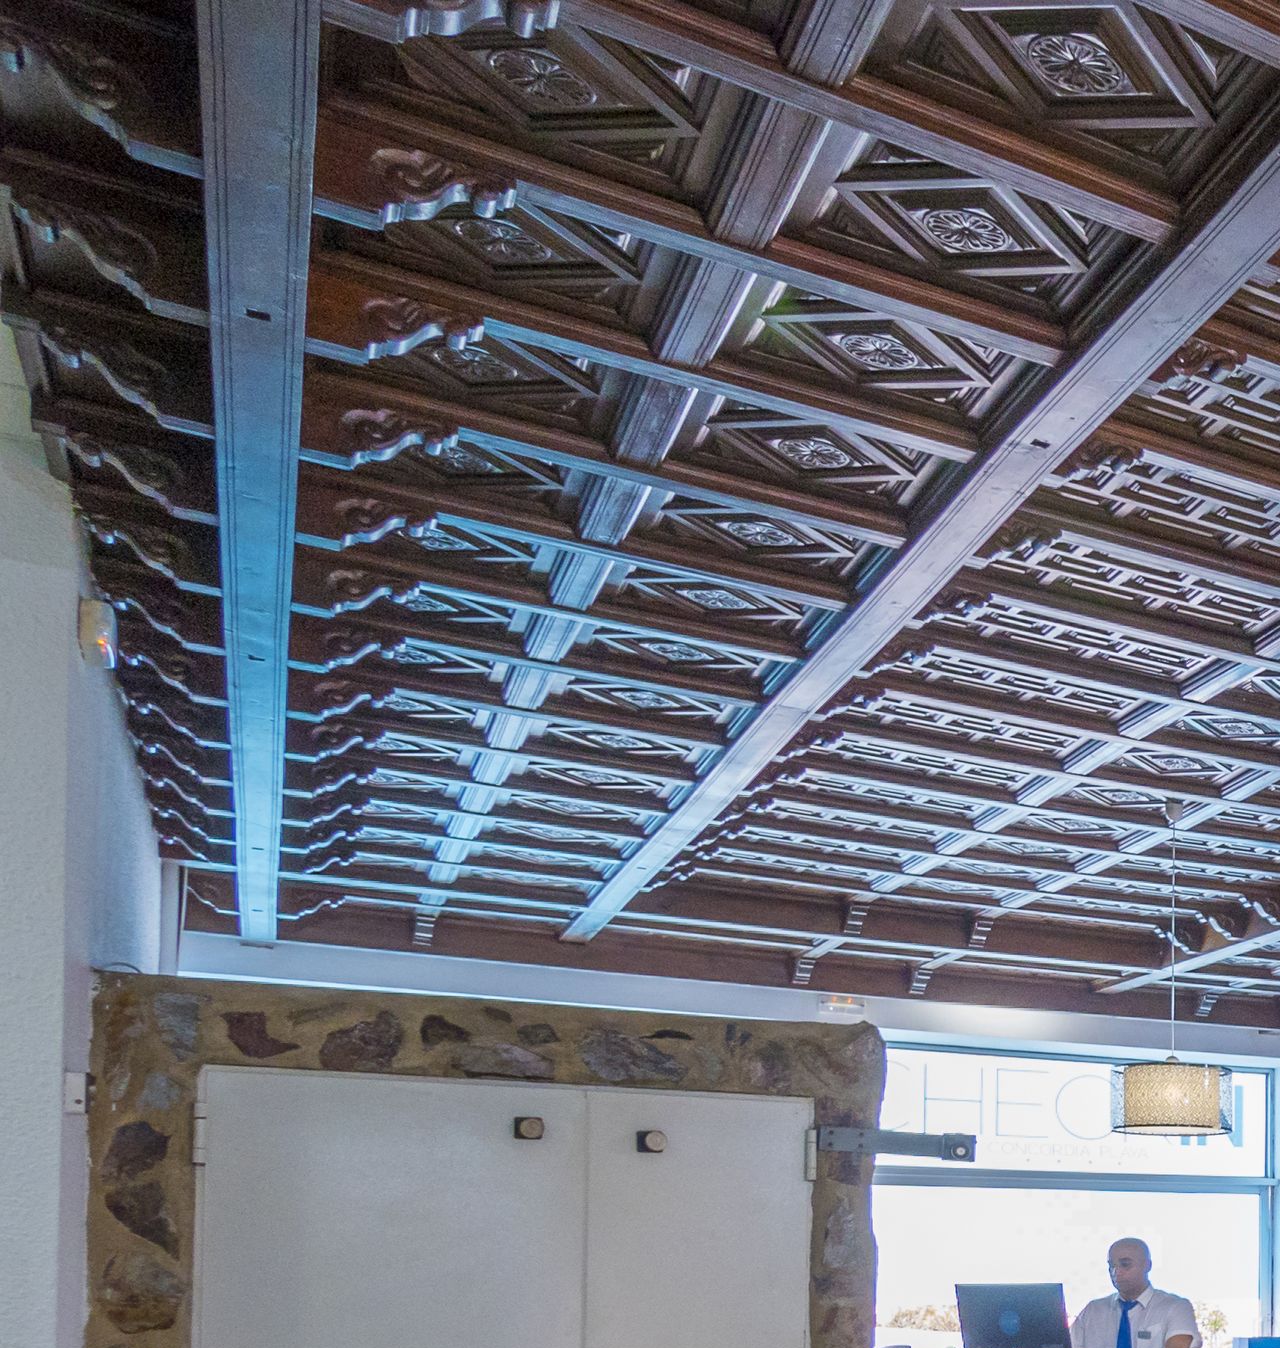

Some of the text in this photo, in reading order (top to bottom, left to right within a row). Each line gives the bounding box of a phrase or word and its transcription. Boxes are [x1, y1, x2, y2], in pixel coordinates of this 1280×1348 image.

[885, 1059, 1172, 1142] HEC
[986, 1141, 1150, 1160] CONCORDIA PLAYA
